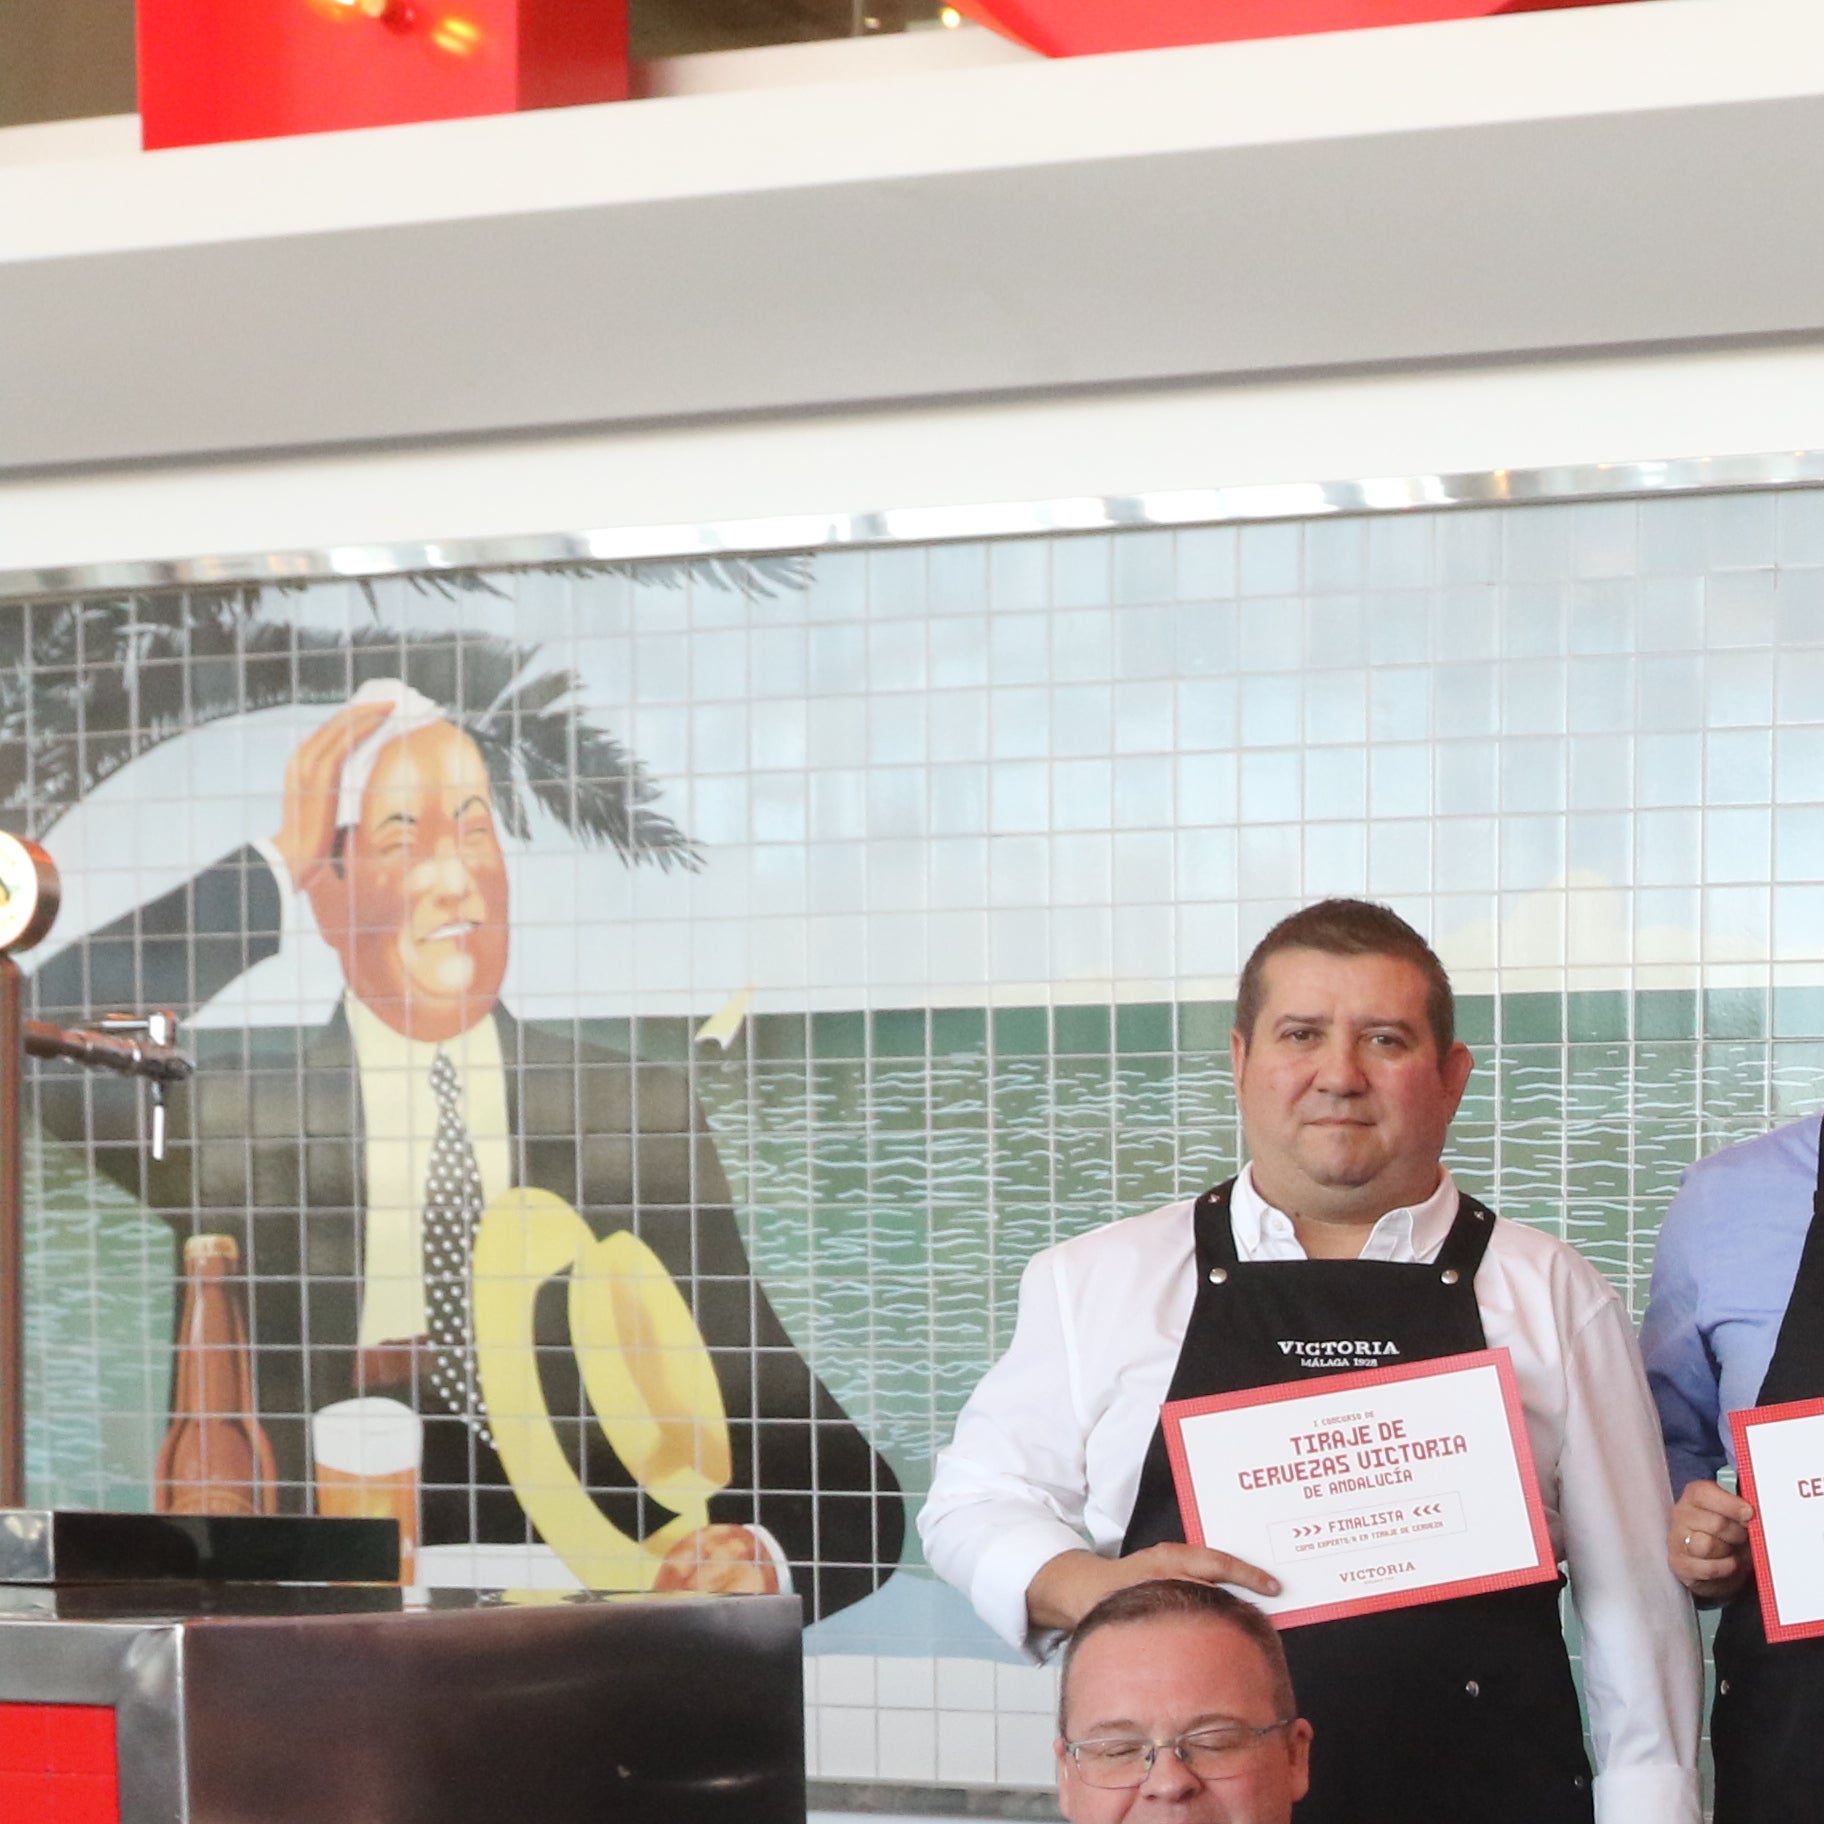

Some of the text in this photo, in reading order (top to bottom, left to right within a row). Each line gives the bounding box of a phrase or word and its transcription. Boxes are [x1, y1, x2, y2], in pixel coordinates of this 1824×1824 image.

[1277, 1341, 1400, 1355] VICTORIA
[1301, 1357, 1349, 1367] MÁLAGA
[1289, 1419, 1407, 1456] TIRAJE DE
[1238, 1434, 1468, 1490] CERVEZAS VICTORIA
[1303, 1466, 1413, 1499] DE ANDALUCÍA
[1327, 1509, 1404, 1532] FINALISTA
[1338, 1560, 1416, 1583] VICTORIA
